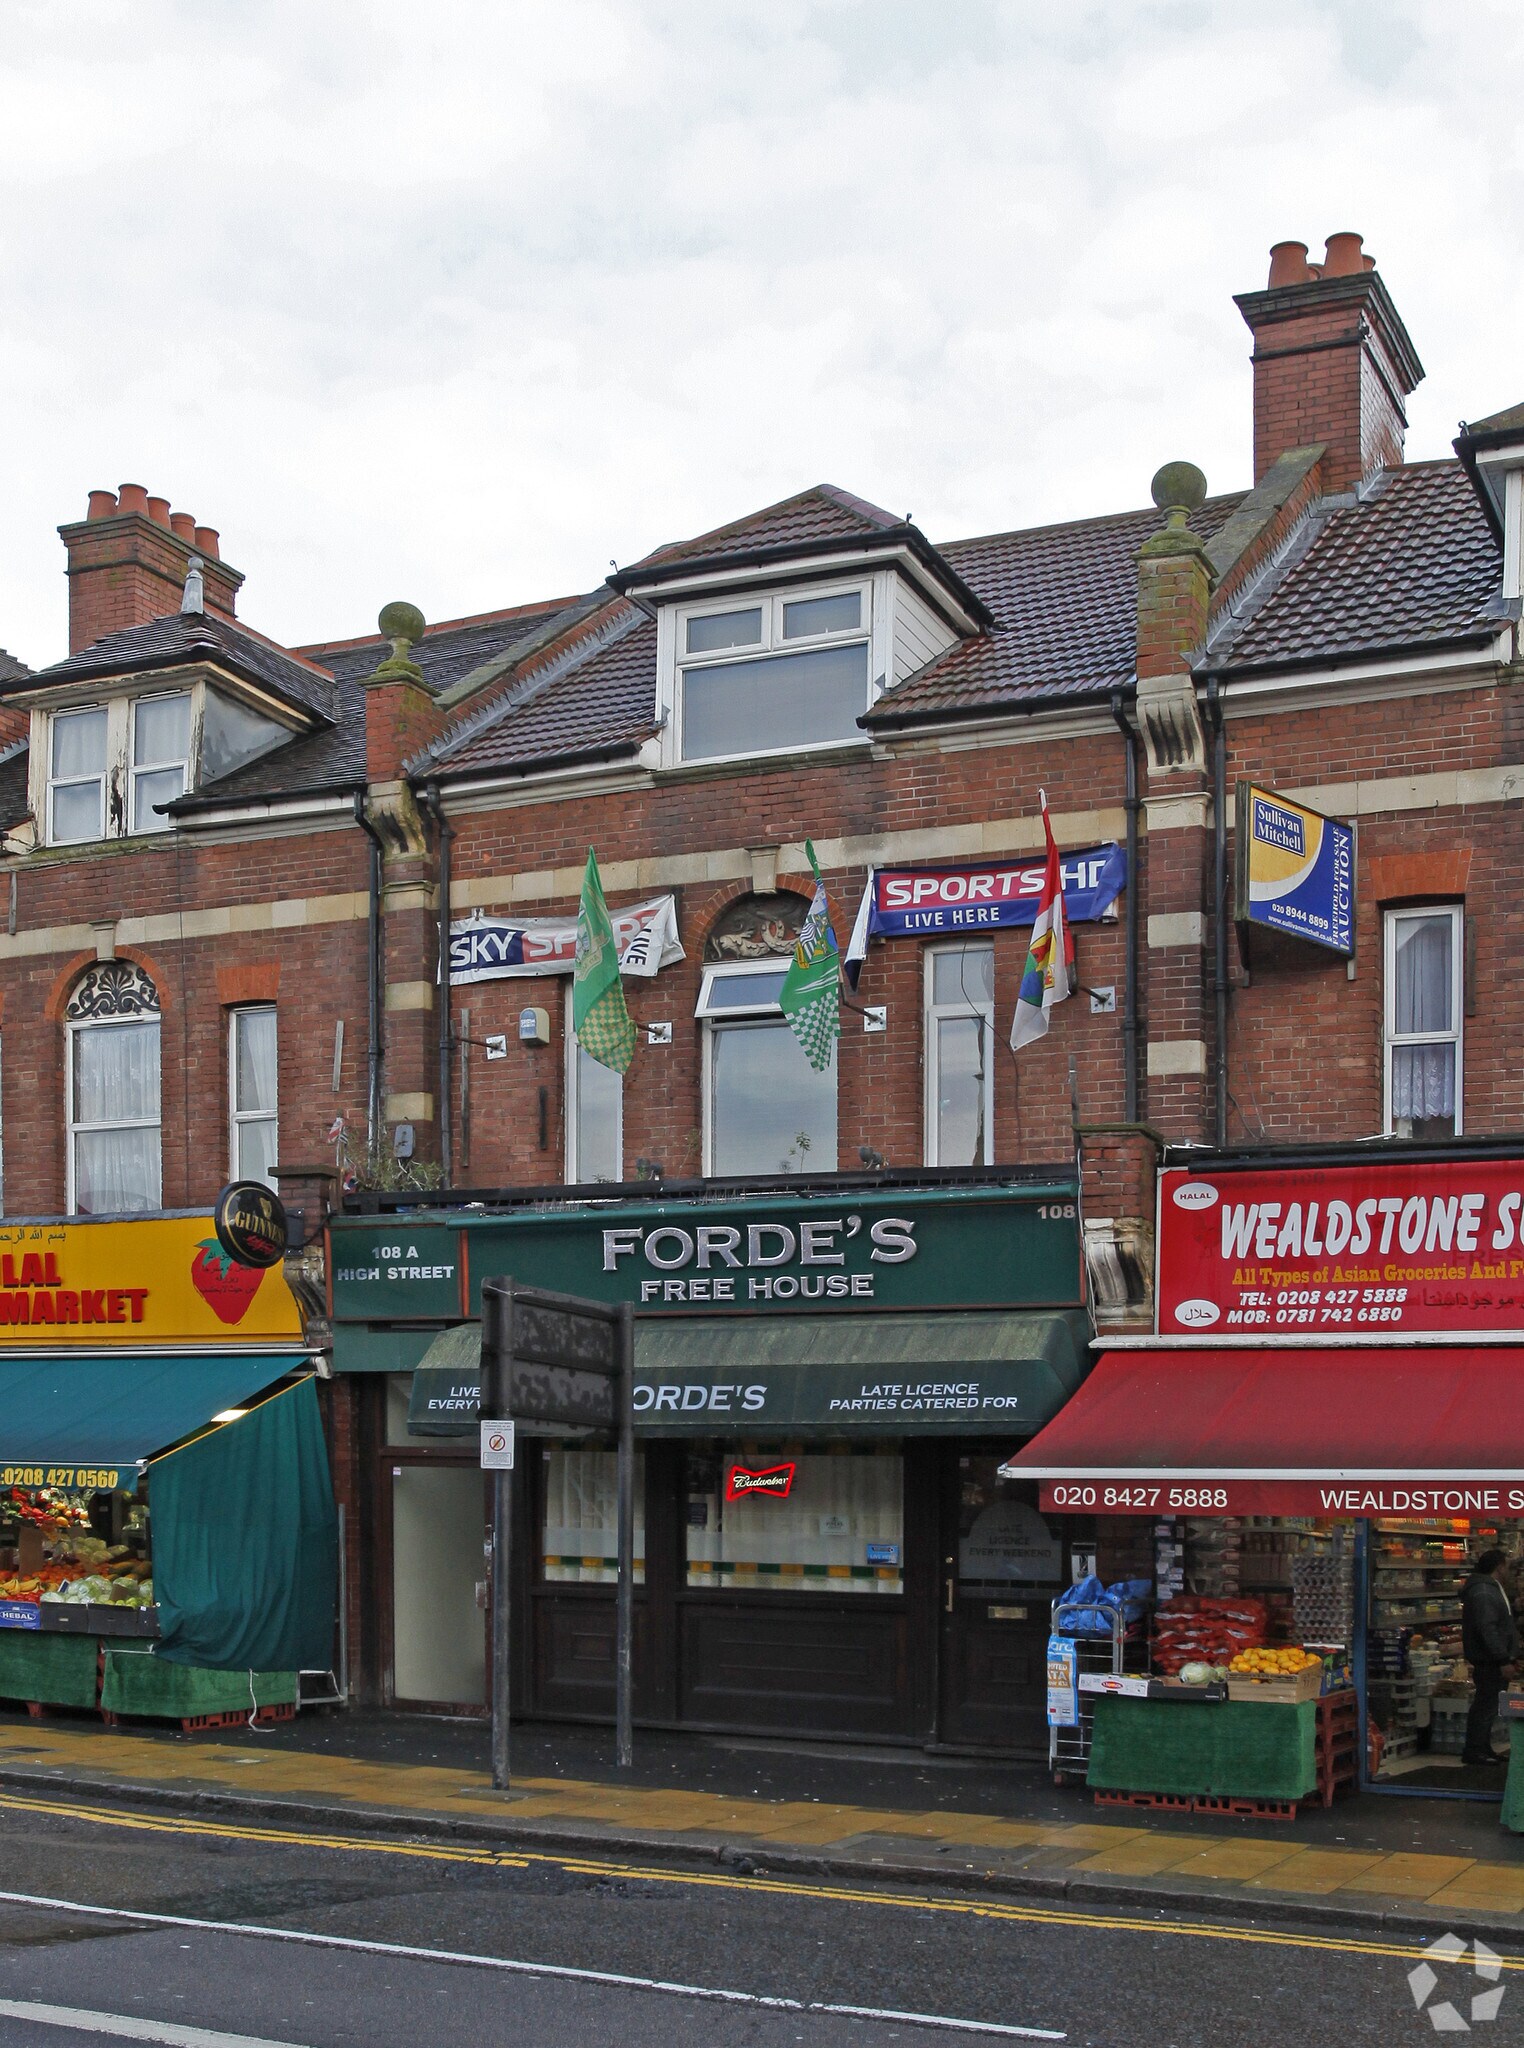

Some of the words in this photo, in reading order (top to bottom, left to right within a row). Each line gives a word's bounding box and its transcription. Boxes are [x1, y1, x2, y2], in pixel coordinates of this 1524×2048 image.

[1258, 805, 1300, 833] Sullivan
[1258, 821, 1301, 850] Mitchell
[1332, 827, 1340, 856] SALE
[886, 868, 1046, 906] SPORTS
[1338, 833, 1350, 944] AUCTION
[905, 912, 944, 928] LIVE
[953, 906, 1000, 924] HERE
[1271, 903, 1285, 914] 020
[1285, 905, 1307, 922] 8944
[1308, 914, 1329, 930] 8899
[1331, 884, 1340, 946] FREEHOLD
[450, 931, 516, 967] SKY
[527, 915, 658, 957] SPR
[1180, 1192, 1212, 1200] HALAL
[1037, 1204, 1076, 1219] 108
[29, 1227, 43, 1240] الله
[1221, 1194, 1485, 1259] WEALDSTONE
[1492, 1192, 1524, 1250] S
[372, 1247, 402, 1259] 108
[406, 1246, 419, 1259] A
[602, 1215, 917, 1271] FORDE'S
[337, 1268, 380, 1281] HIGH
[387, 1266, 455, 1280] STREET
[1232, 1268, 1256, 1285] All
[1259, 1267, 1308, 1288] Types
[1312, 1266, 1329, 1284] of
[1332, 1264, 1381, 1283] Asian
[1384, 1262, 1466, 1282] Groceries
[1470, 1261, 1506, 1279] And
[1510, 1260, 1524, 1279] F
[641, 1278, 736, 1302] FREE
[748, 1273, 875, 1299] HOUSE
[1239, 1291, 1272, 1306] TEL:
[1277, 1290, 1321, 1306] 0208
[1325, 1289, 1359, 1304] 427
[1362, 1288, 1408, 1303] 5888
[1184, 1308, 1213, 1321] حلال
[1227, 1308, 1271, 1324] MOB:
[1275, 1308, 1316, 1323] 0781
[1320, 1308, 1352, 1323] 742
[1357, 1306, 1402, 1322] 6880
[450, 1387, 481, 1397] LIVE
[634, 1385, 768, 1411] ORDE'S
[861, 1384, 902, 1397] LATE
[906, 1383, 980, 1396] LICENCE
[428, 1400, 474, 1410] EVERY
[829, 1399, 898, 1411] PARTIES
[900, 1397, 979, 1410] CATERED
[982, 1396, 1018, 1409] FOR
[46, 1469, 75, 1487] 427
[76, 1470, 118, 1489] 0560
[1053, 1486, 1097, 1506] 020
[1103, 1487, 1161, 1507] 8427
[1168, 1488, 1228, 1508] 5888
[1320, 1489, 1501, 1510] WEALDSTONE
